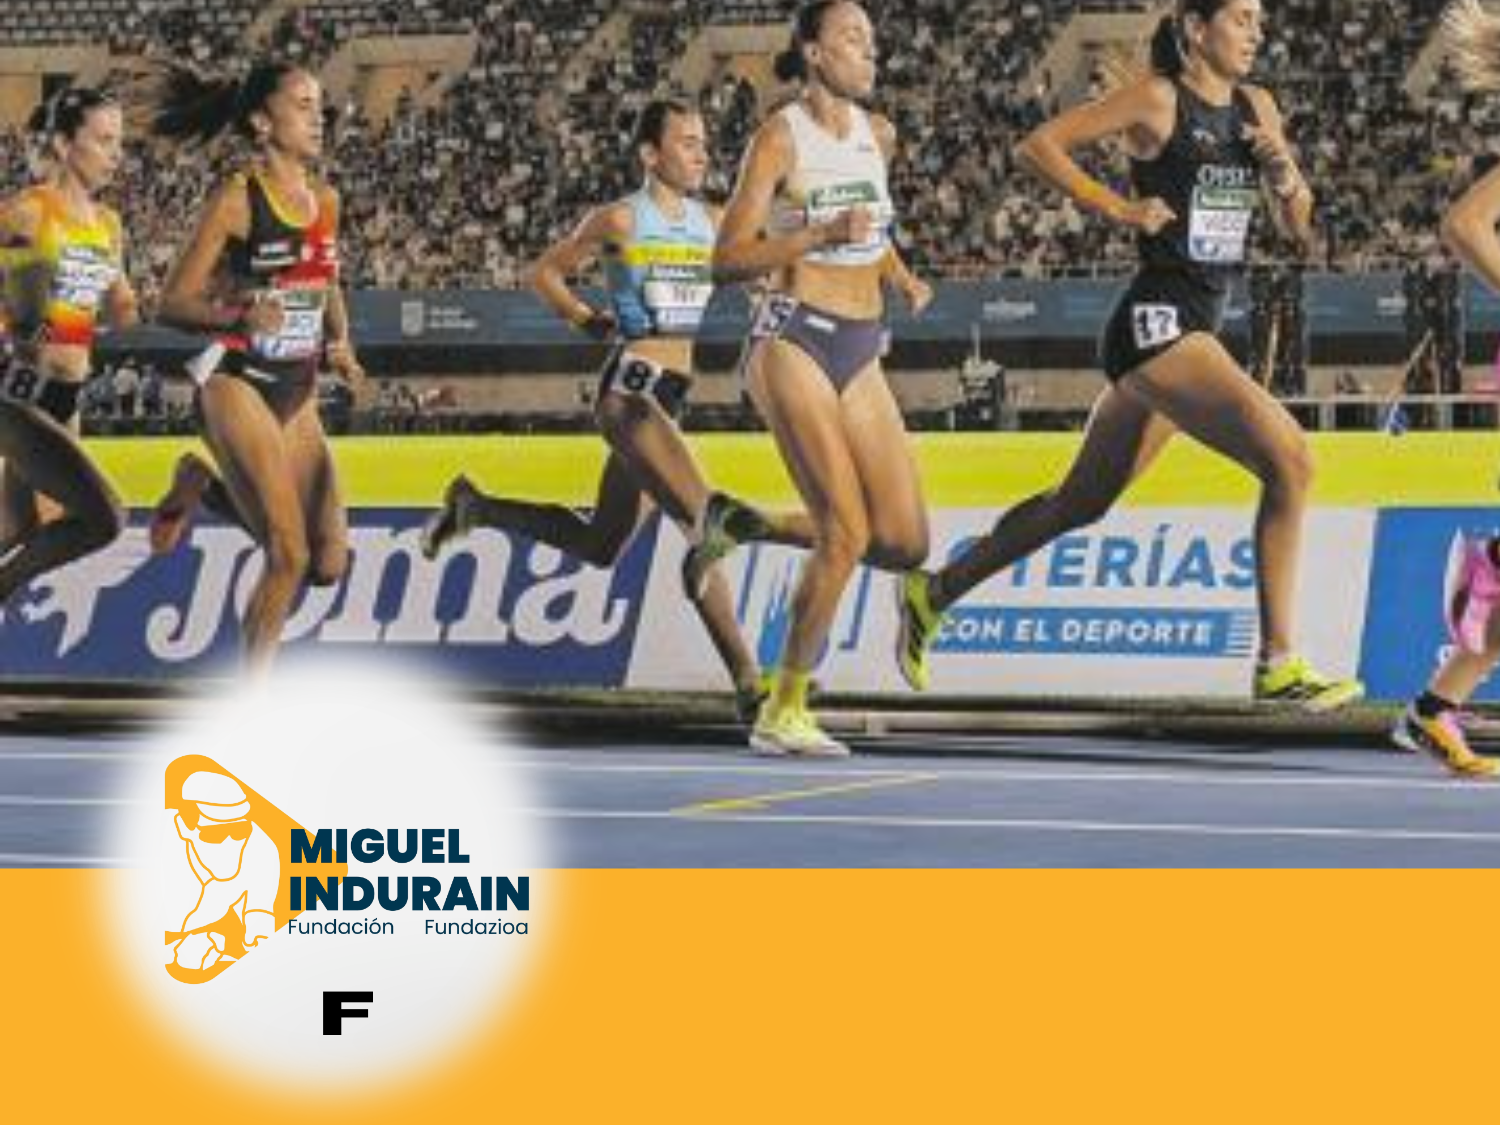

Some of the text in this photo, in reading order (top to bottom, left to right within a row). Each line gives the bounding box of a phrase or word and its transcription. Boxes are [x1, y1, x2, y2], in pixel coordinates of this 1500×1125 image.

[1137, 311, 1173, 340] 17
[625, 360, 651, 391] 8
[949, 524, 1257, 587] ERÍAS
[1014, 620, 1050, 642] EL
[1062, 620, 1212, 645] DEPORTE
